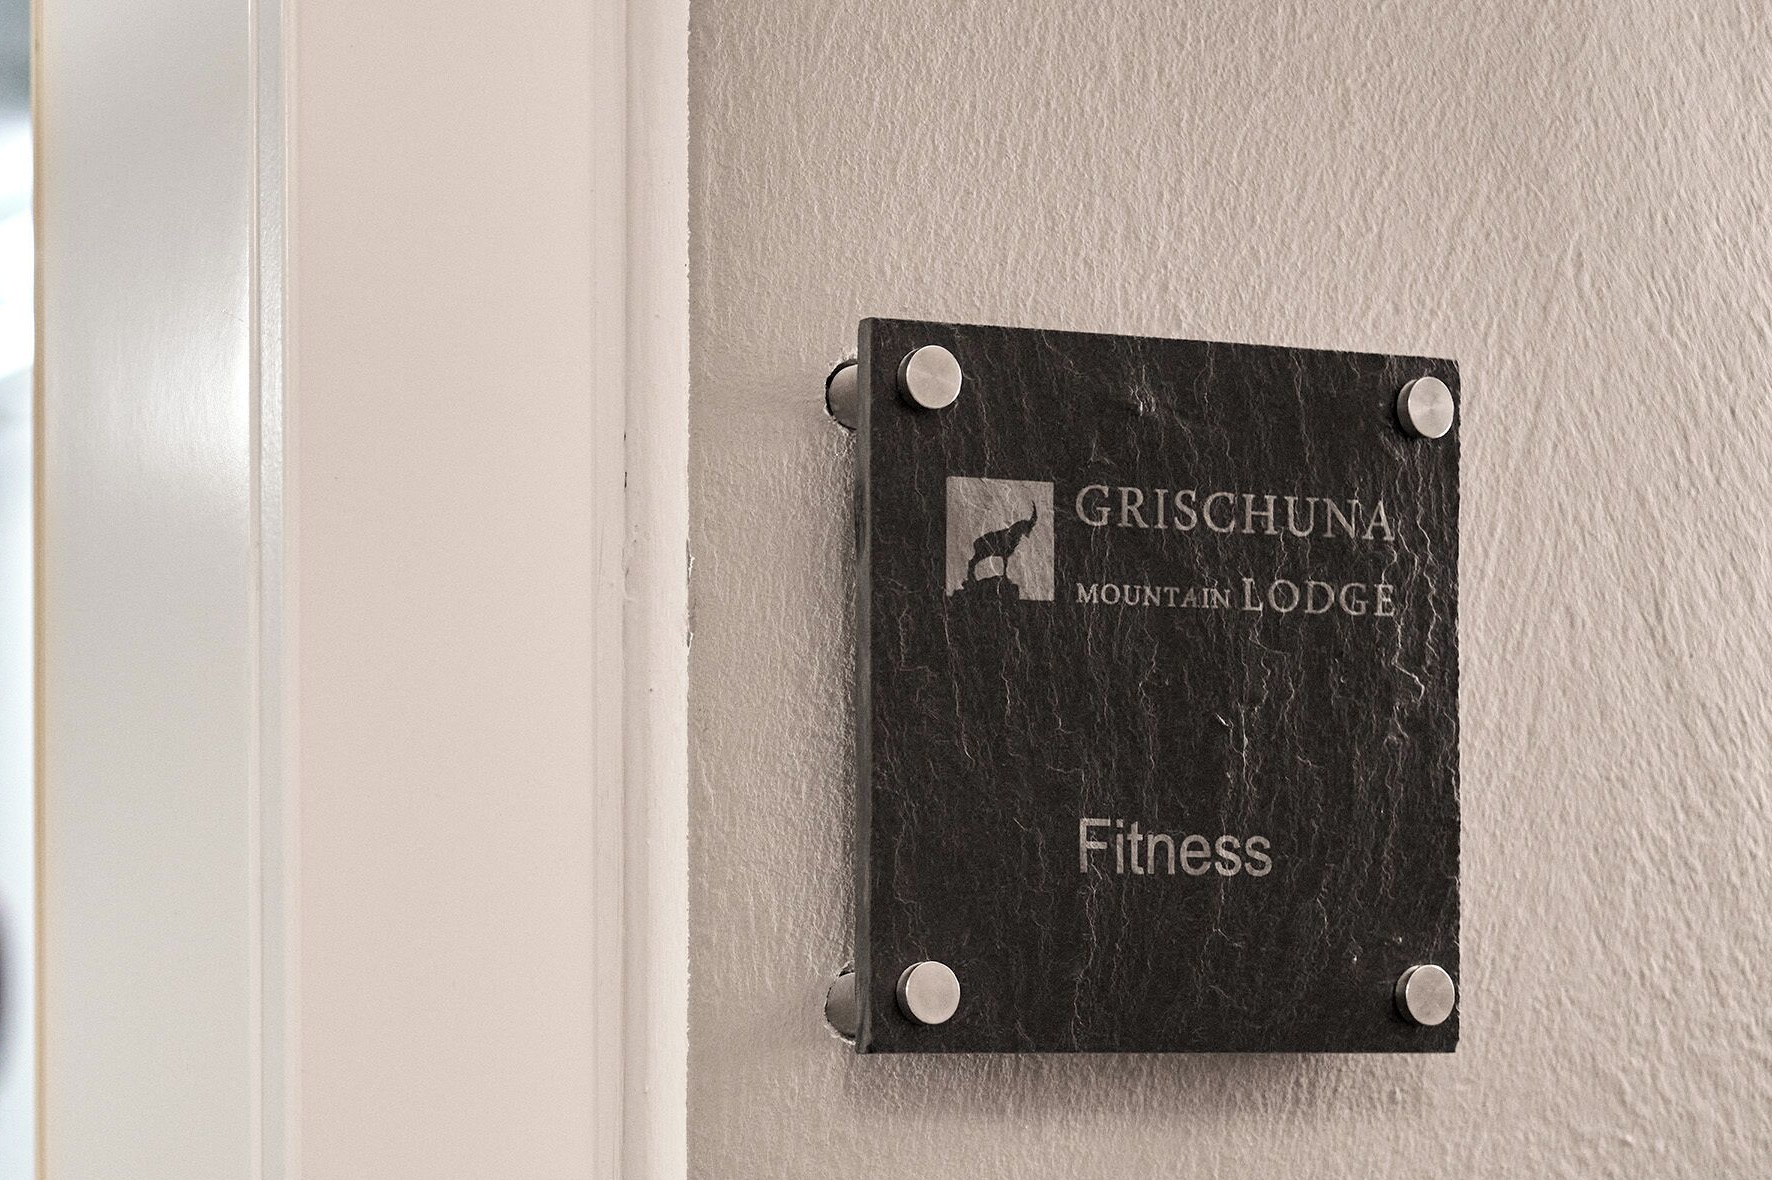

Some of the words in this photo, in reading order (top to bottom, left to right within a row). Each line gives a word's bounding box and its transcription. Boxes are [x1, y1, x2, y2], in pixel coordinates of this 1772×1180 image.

[1075, 484, 1396, 541] GRISCHUNA
[1076, 582, 1230, 610] MOUNTAIN
[1241, 577, 1397, 617] LODGE
[1079, 818, 1273, 877] Fitness
